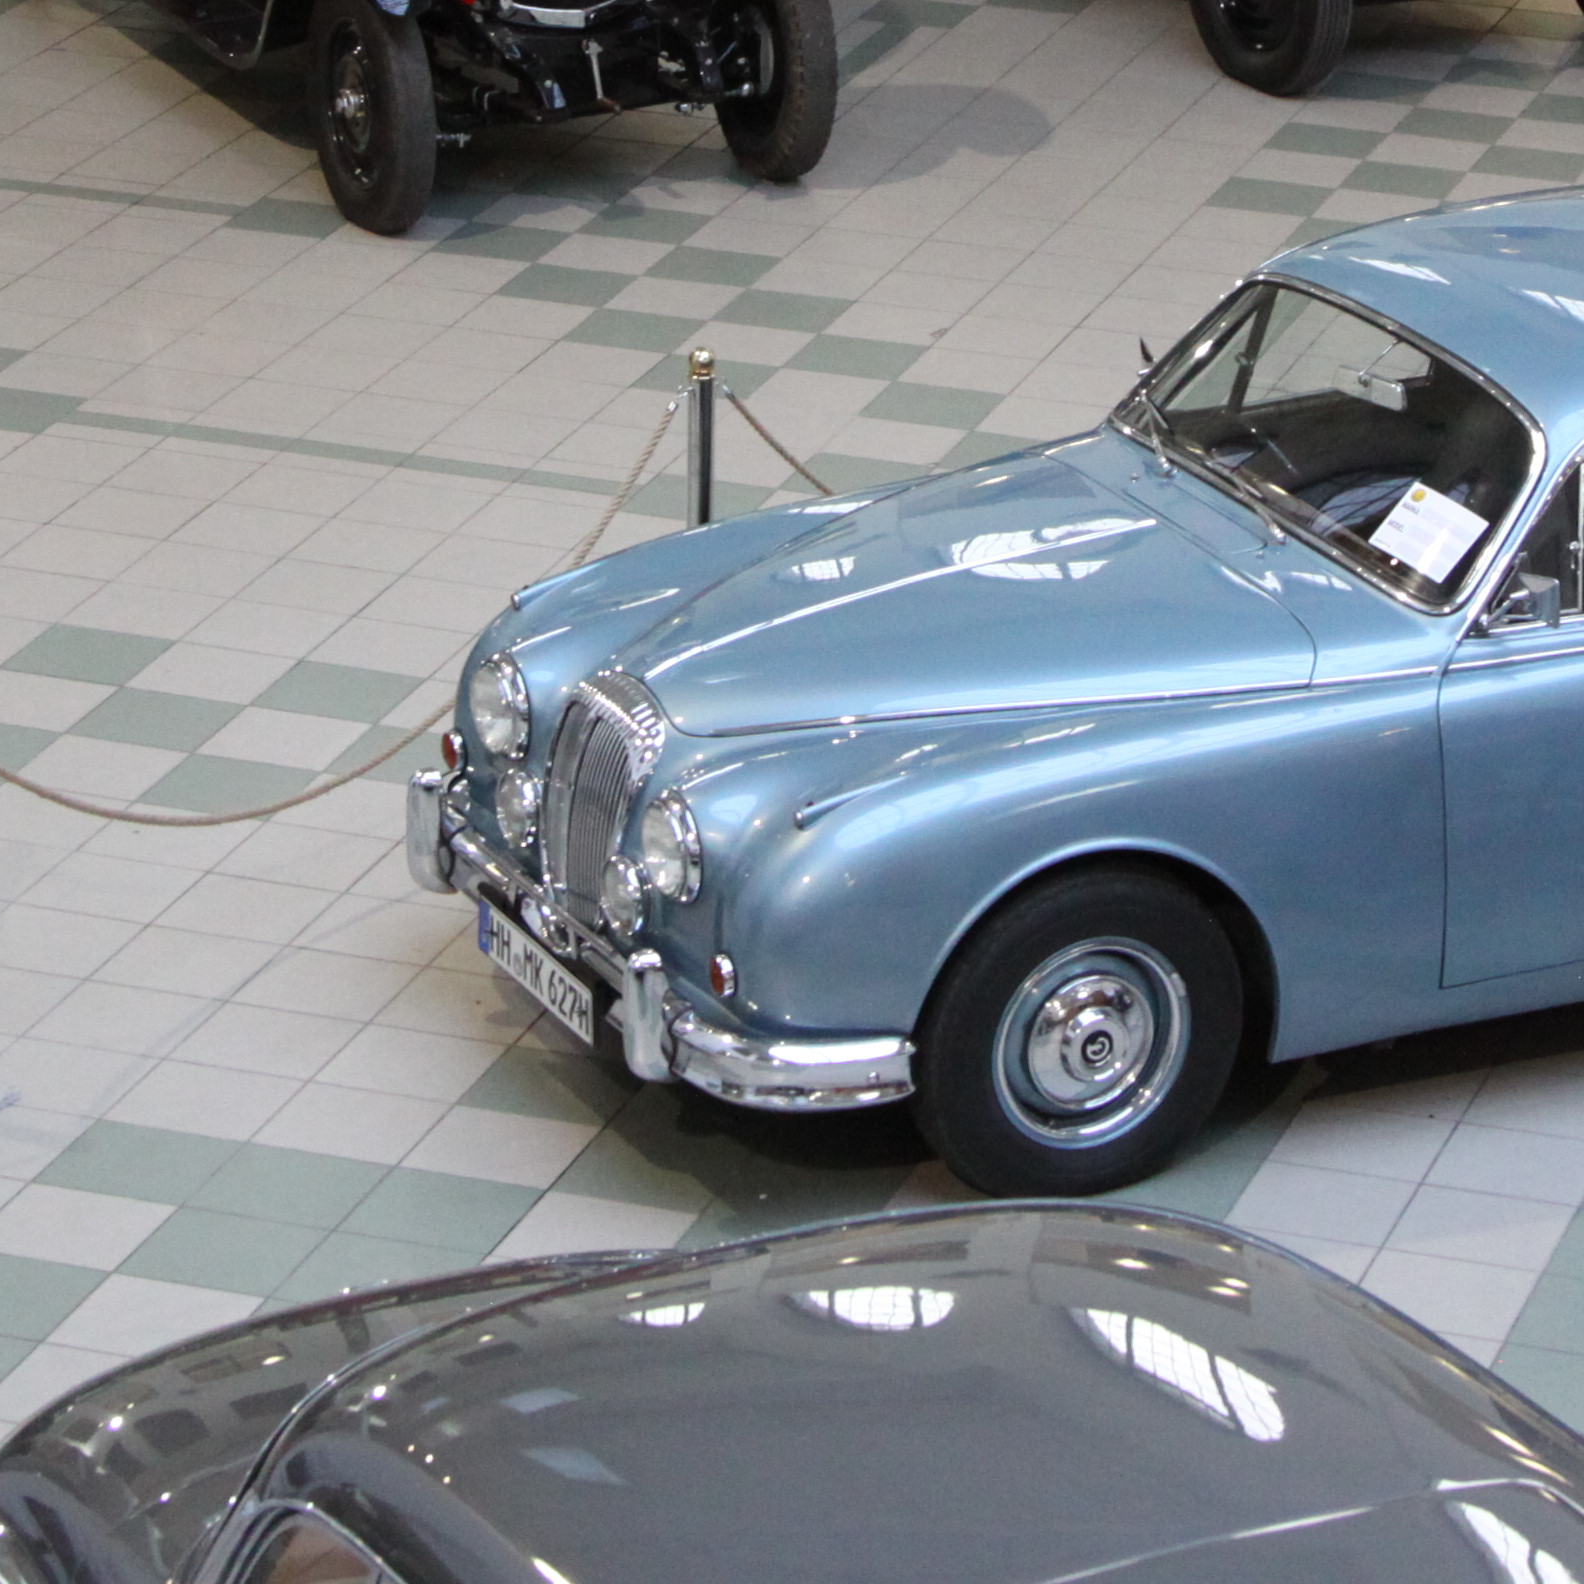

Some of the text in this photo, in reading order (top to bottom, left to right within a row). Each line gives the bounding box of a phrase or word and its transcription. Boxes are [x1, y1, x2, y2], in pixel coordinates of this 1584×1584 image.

[490, 915, 590, 1035] HH MK 627H
